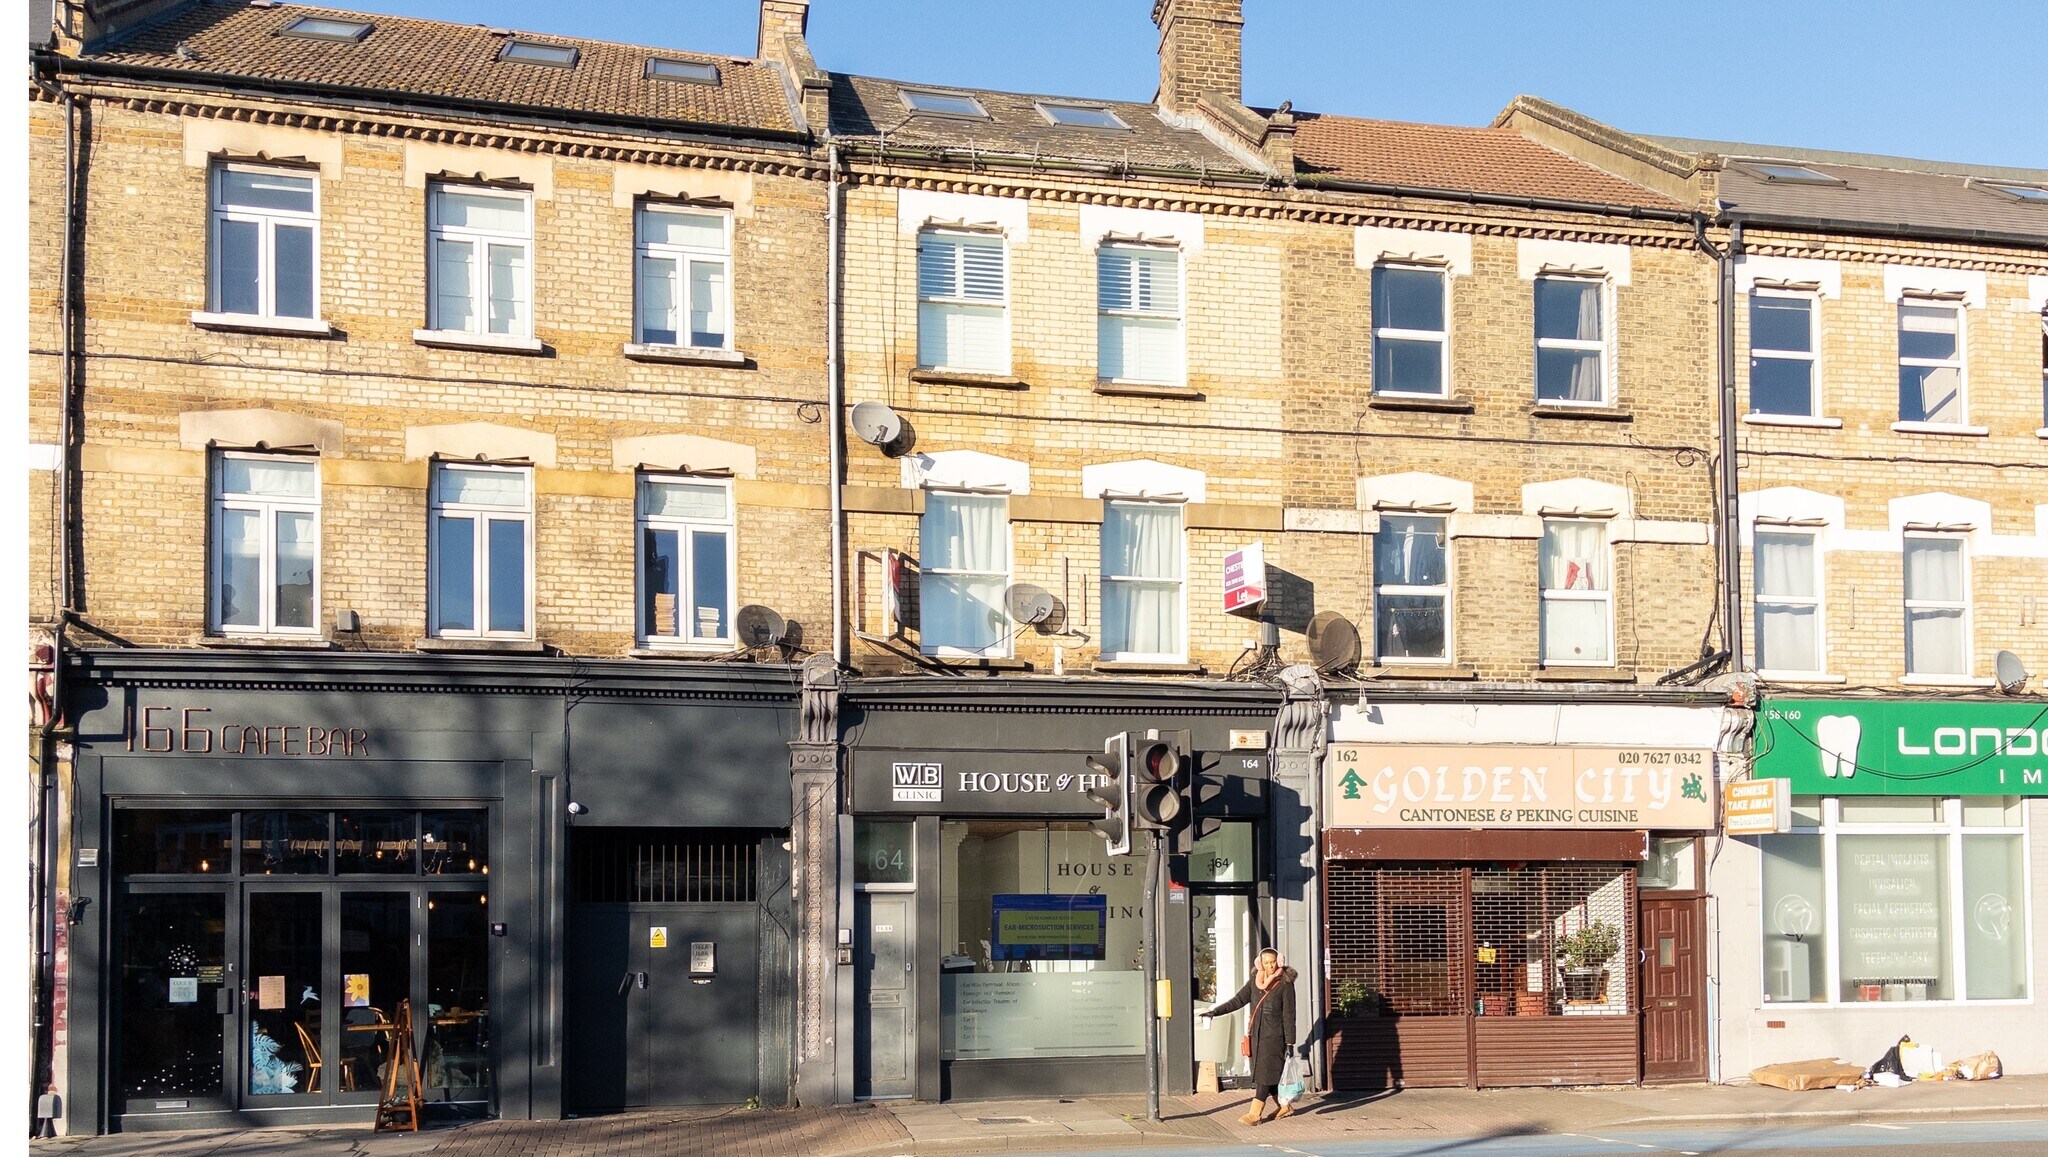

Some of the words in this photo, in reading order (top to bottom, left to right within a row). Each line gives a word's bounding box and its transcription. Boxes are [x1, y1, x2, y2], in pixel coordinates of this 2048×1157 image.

[1236, 590, 1248, 603] Let
[127, 705, 212, 753] 166
[220, 724, 301, 756] CAFE
[307, 725, 369, 756] BAR
[1897, 727, 2048, 755] LOND
[1336, 750, 1358, 762] 162
[1618, 752, 1640, 764] 020
[1643, 752, 1671, 764] 7627
[1674, 752, 1702, 765] 0342
[1241, 760, 1259, 769] 164
[958, 772, 1051, 793] HOUSE
[1338, 767, 1368, 800] 金
[1681, 772, 1707, 803] 城
[897, 791, 937, 800] CLINIC
[1371, 765, 1548, 814] GOLDEN
[1575, 767, 1674, 811] CITY
[1732, 784, 1769, 798] CHINESE
[1727, 800, 1749, 811] TAKE
[1749, 798, 1773, 810] AWAY
[1399, 808, 1496, 822] CANTONESE
[1499, 809, 1513, 822] &
[1516, 809, 1574, 823] PEKING
[1578, 809, 1639, 823] CUISINE
[1210, 858, 1230, 868] 164
[1854, 853, 1885, 865] DENTAL
[1887, 853, 1929, 865] IMPLANTS
[1057, 863, 1134, 876] HOUSE
[1853, 902, 1881, 914] FACIAL
